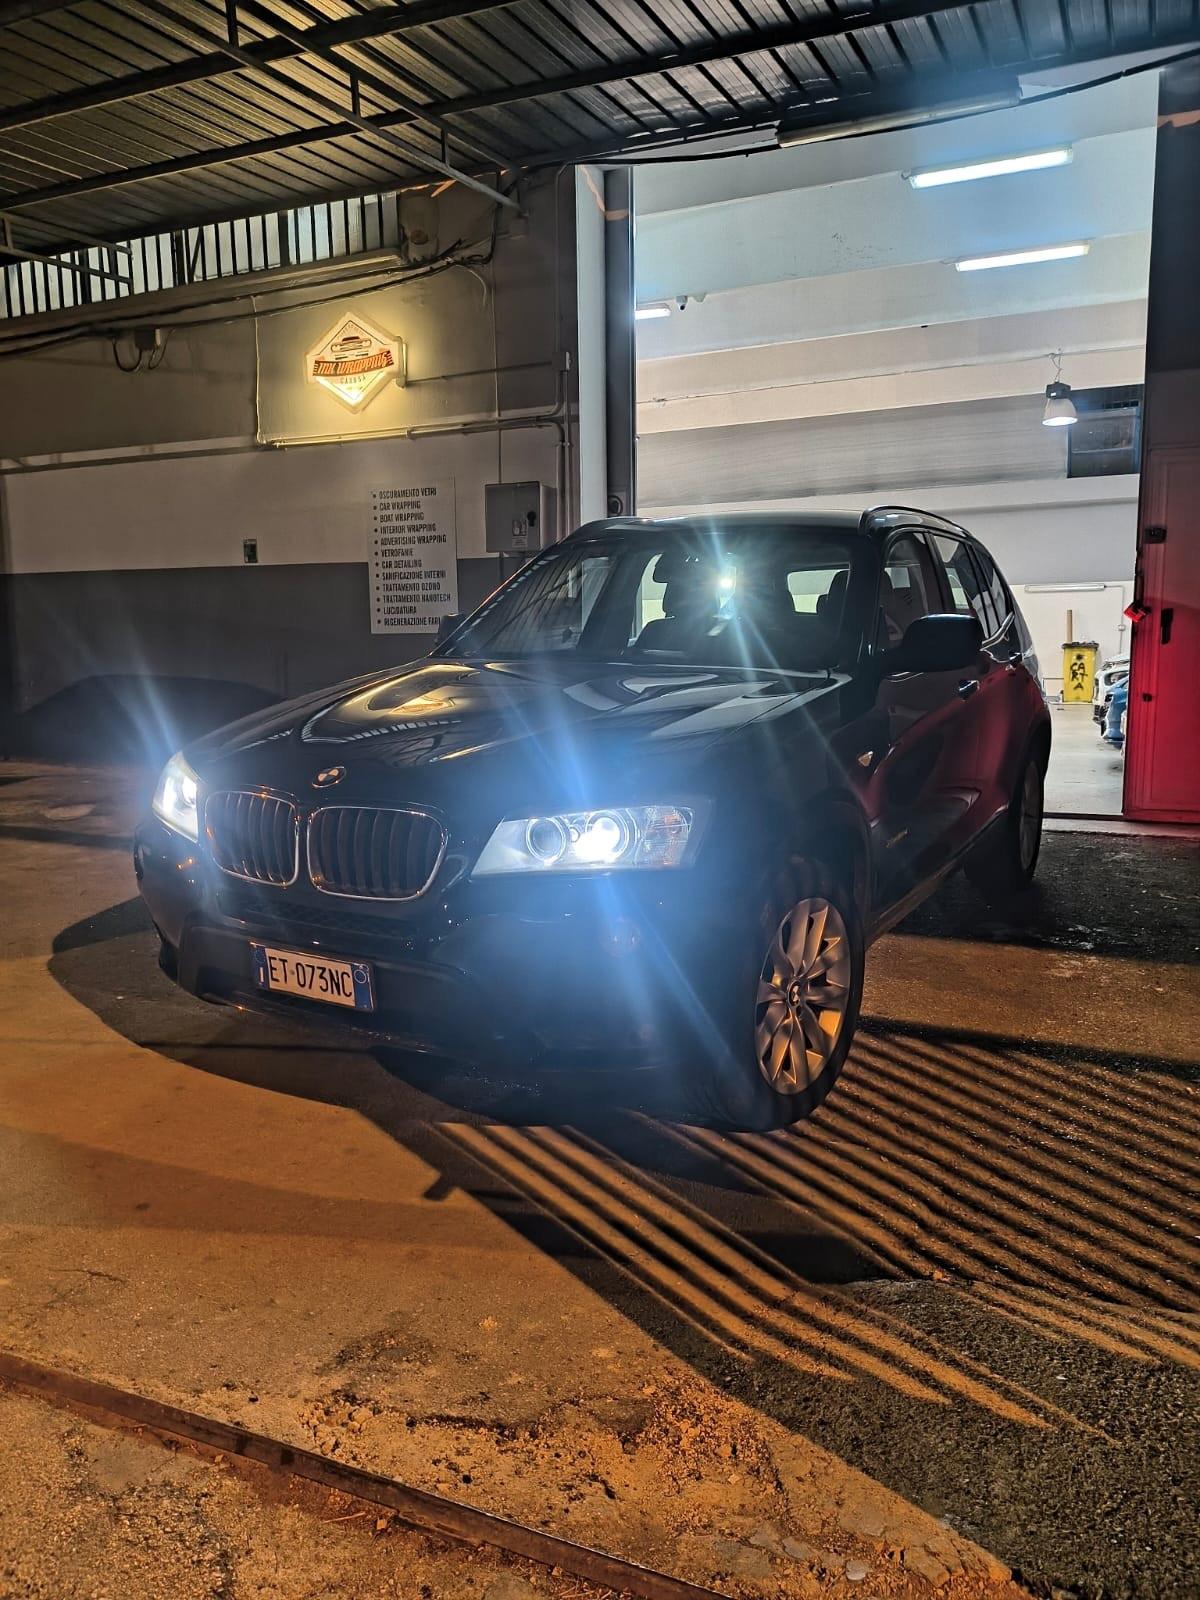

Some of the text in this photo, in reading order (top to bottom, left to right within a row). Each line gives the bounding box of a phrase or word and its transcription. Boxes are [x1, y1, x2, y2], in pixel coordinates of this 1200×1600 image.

[337, 352, 387, 374] WRAPPING
[379, 487, 437, 499] OSCURAMENTO VETRI
[380, 500, 421, 511] CAR WRAPPING
[380, 511, 424, 523] BOAT WRAPPING
[380, 523, 436, 534] INTERIOR WRAPPING
[381, 534, 447, 545] ADVERTISING WRAPPING
[381, 548, 413, 557] VETROFANIE
[381, 559, 422, 569] CAR DETAILING
[382, 571, 423, 580] SANIFICAZIONE
[383, 582, 441, 592] TRATTAMENTO OZONO
[383, 592, 451, 603] TRATTAMENTO NANOTECH
[383, 606, 417, 615] LUCIDATURA
[384, 617, 427, 626] RIGENERAZIONE
